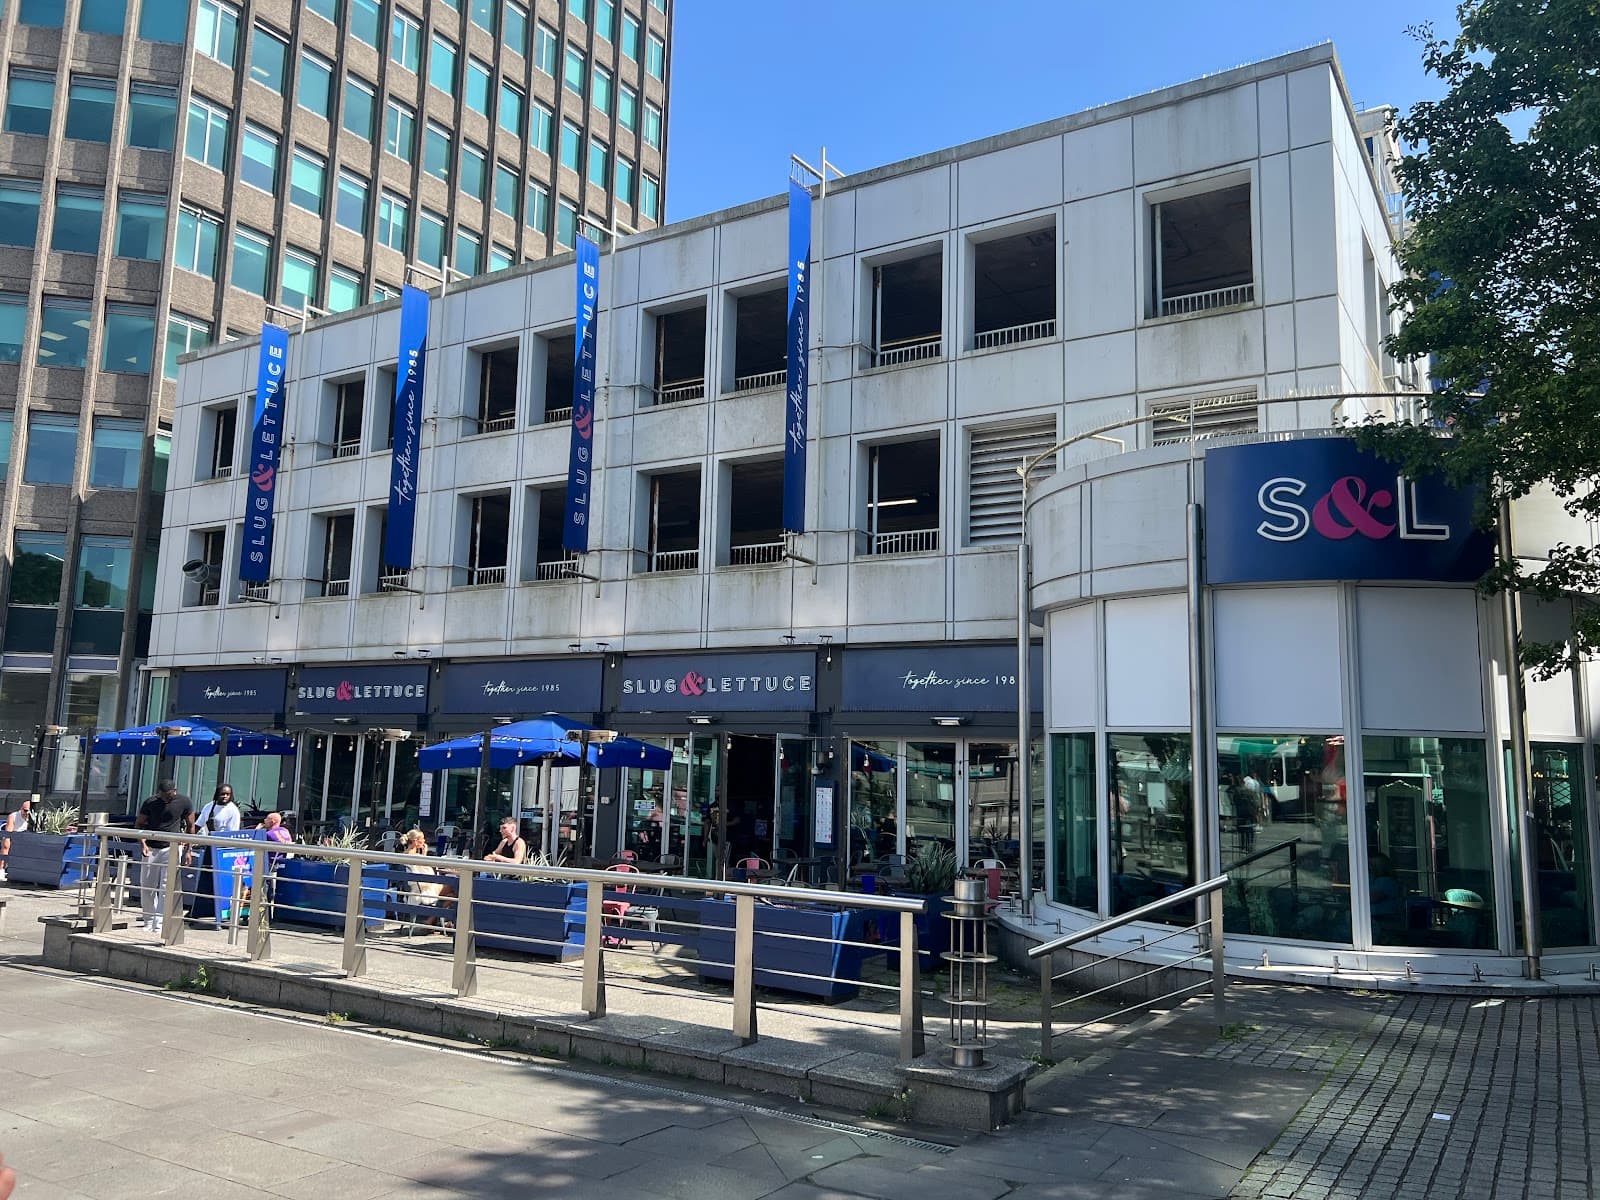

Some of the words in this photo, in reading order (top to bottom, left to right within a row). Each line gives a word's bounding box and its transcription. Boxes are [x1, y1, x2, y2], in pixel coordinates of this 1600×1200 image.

[797, 260, 805, 302] 1985
[797, 311, 806, 368] since
[408, 349, 419, 383] 1985
[405, 390, 415, 435] since
[789, 367, 804, 455] together
[394, 435, 412, 504] together
[481, 680, 515, 697] together
[516, 685, 538, 695] since
[541, 683, 560, 692] 1985
[897, 669, 952, 690] together
[952, 678, 990, 689] since
